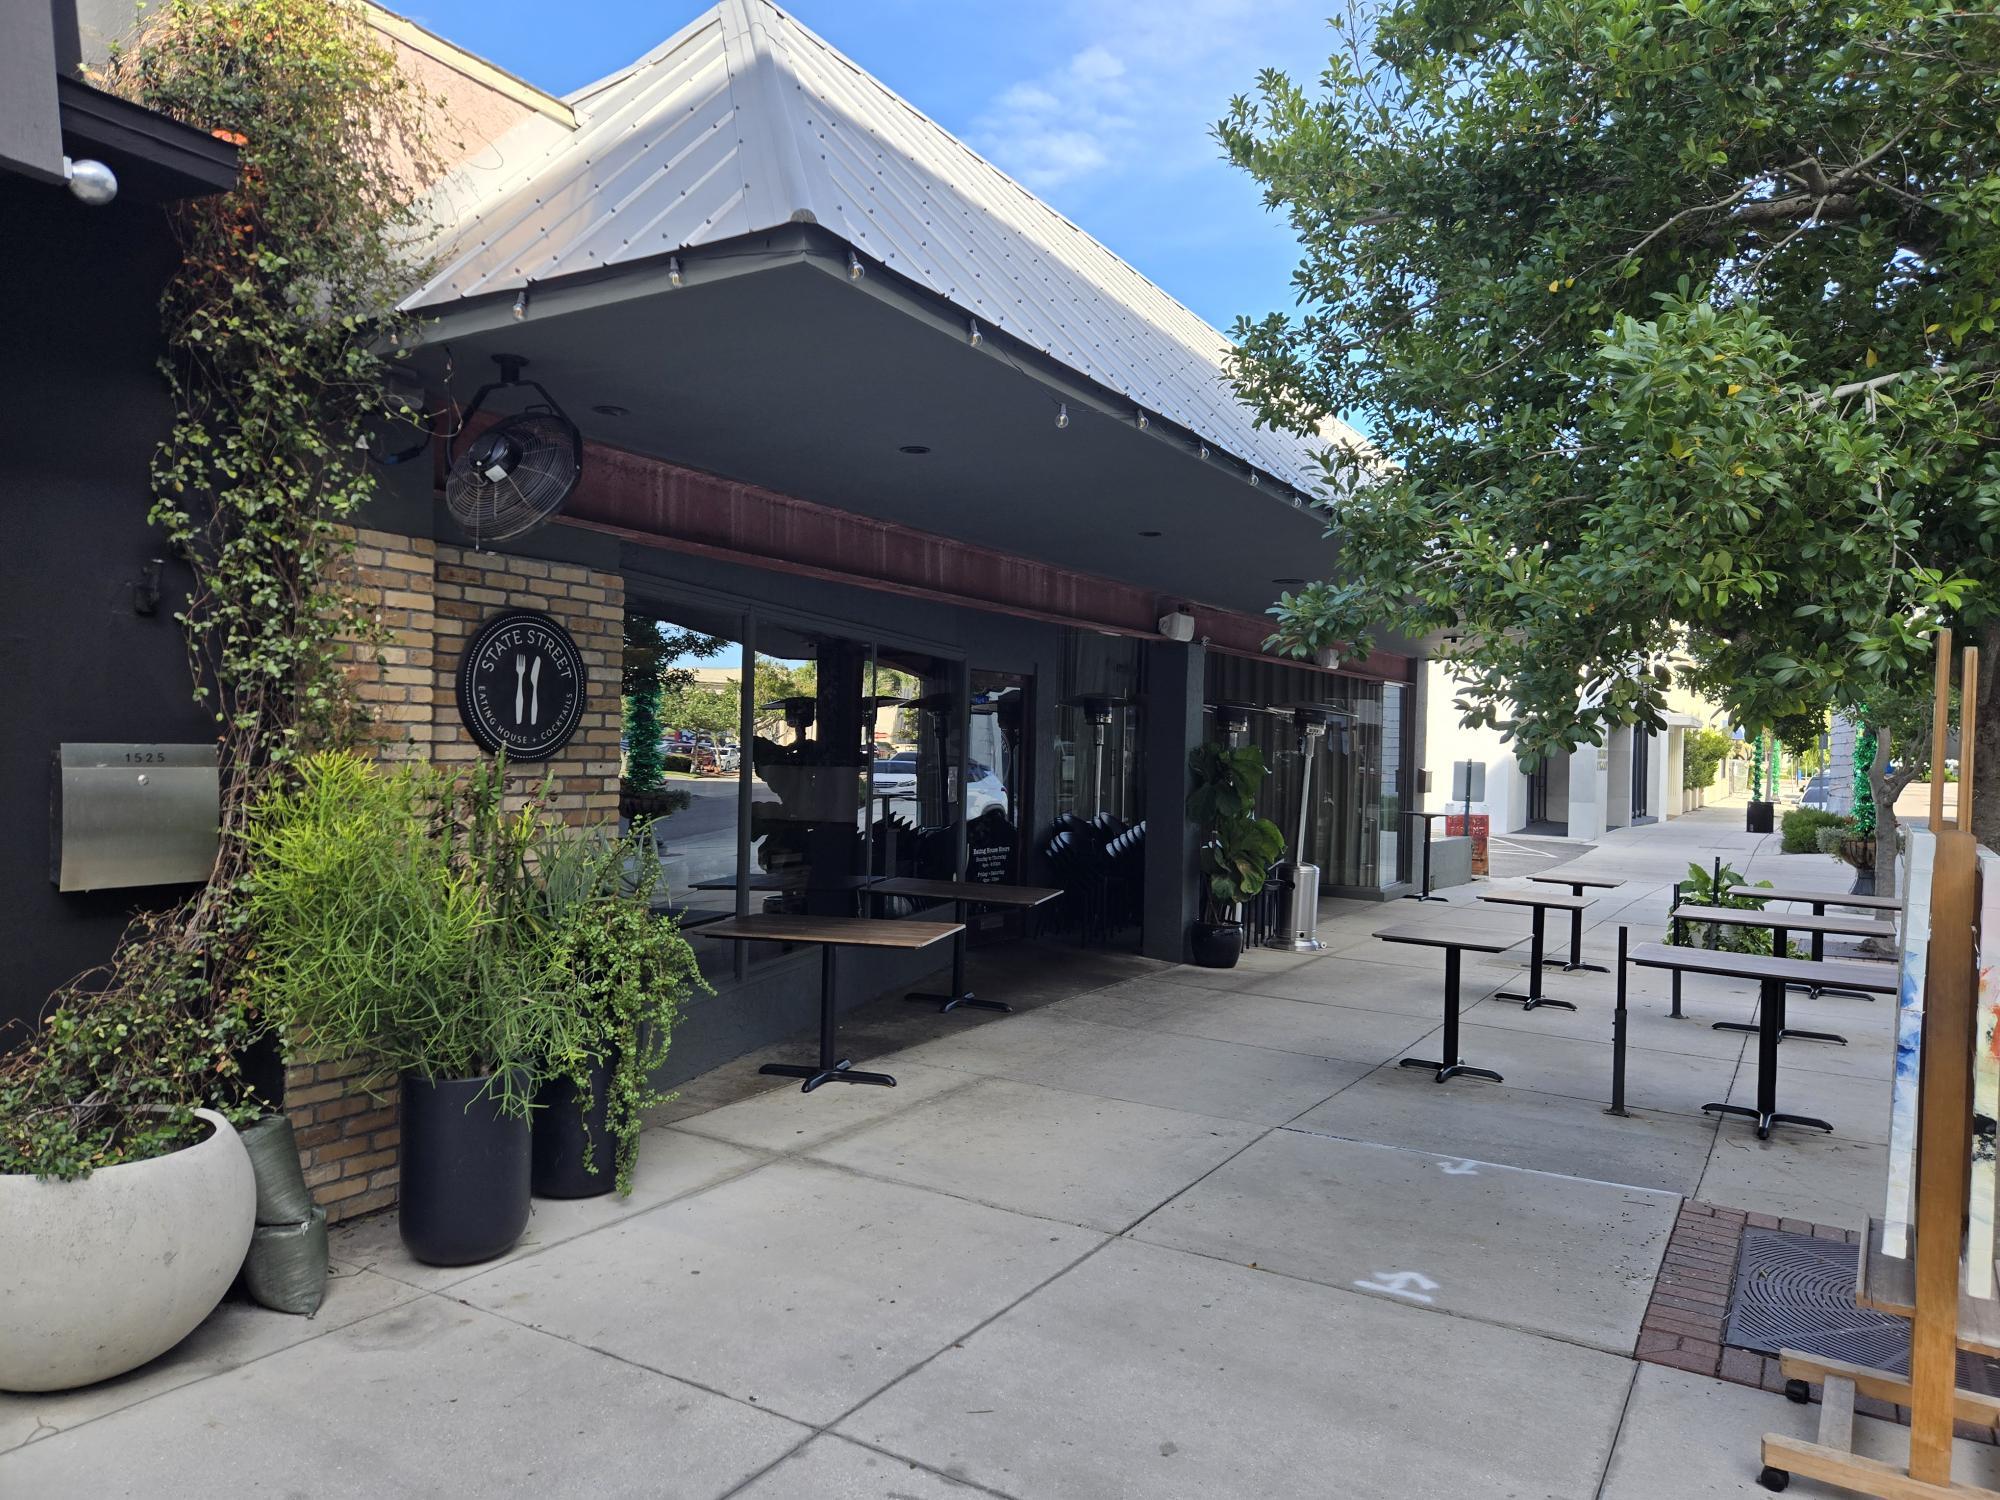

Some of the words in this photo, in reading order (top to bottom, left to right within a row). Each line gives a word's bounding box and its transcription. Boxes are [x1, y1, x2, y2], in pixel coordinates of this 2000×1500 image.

[481, 630, 523, 673] STATE
[527, 630, 572, 679] STREET
[478, 685, 497, 726] EATING
[497, 724, 528, 744] HOUSE
[540, 693, 573, 740] COCKTAILS
[125, 752, 166, 763] 1525
